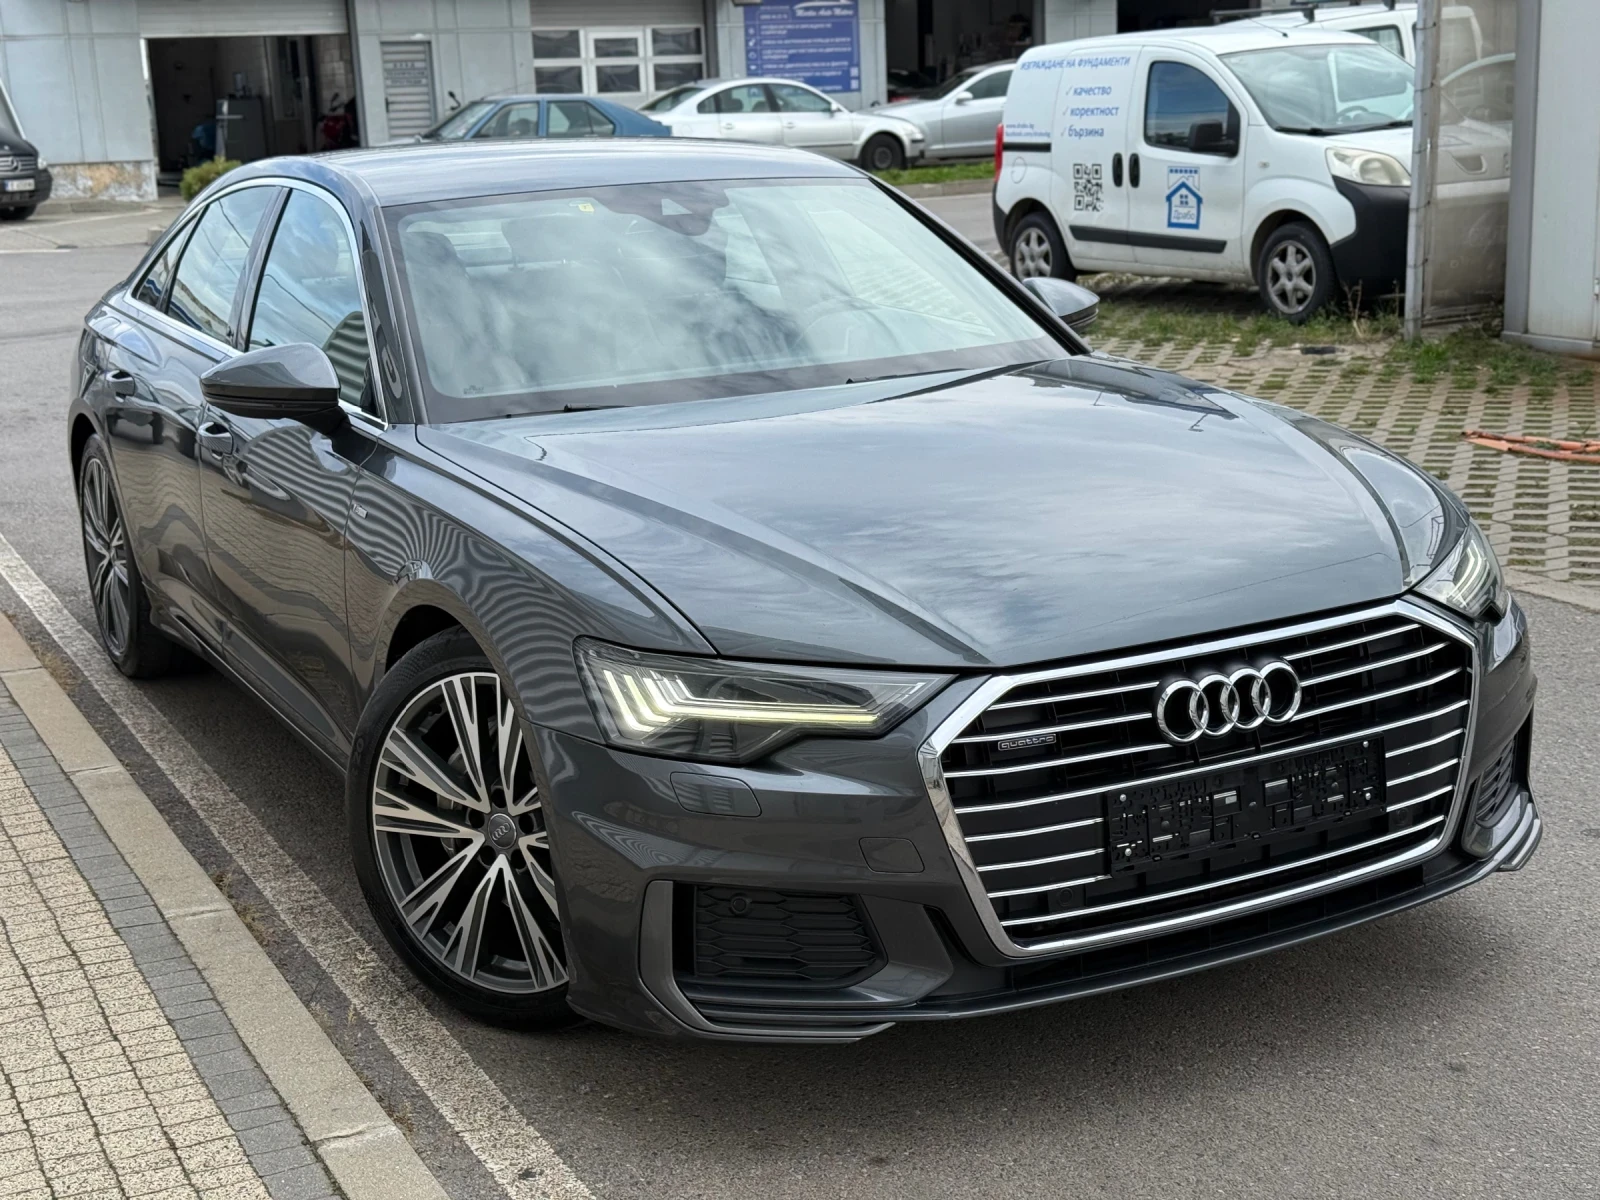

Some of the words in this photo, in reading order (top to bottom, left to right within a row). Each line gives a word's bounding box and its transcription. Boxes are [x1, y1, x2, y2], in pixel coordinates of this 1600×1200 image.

[1021, 60, 1065, 70] ИЗГРАЖДАНЕ
[1066, 60, 1076, 68] НА
[1078, 56, 1131, 69] ФУНДАМЕНТИ
[1073, 86, 1112, 96] качество
[1070, 107, 1119, 119] коректност
[1068, 124, 1104, 139] бързина
[1001, 736, 1054, 749] quattro
